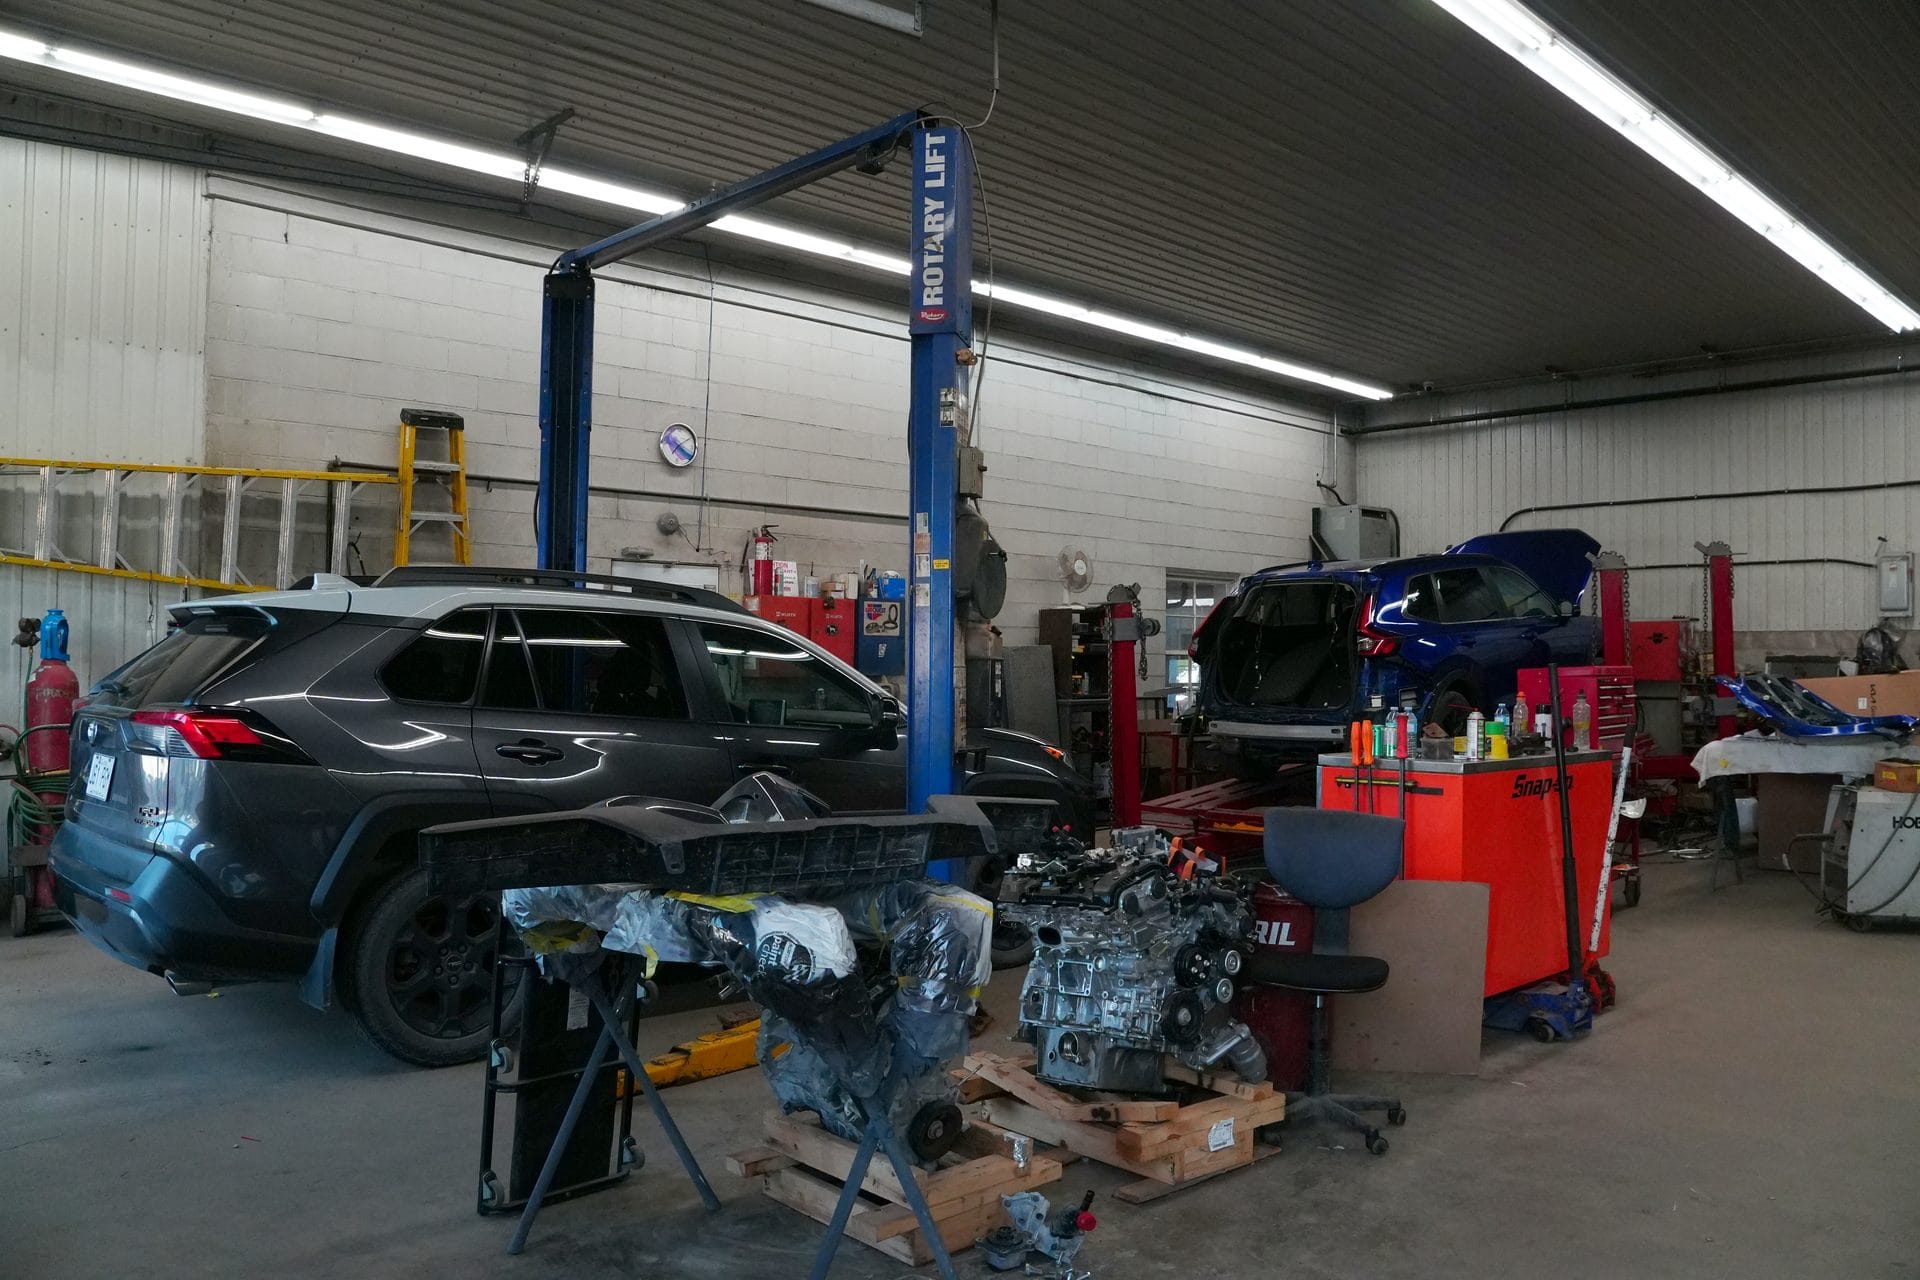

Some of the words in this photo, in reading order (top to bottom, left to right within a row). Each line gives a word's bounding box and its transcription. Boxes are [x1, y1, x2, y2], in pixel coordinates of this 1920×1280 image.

[924, 133, 946, 188] LIFT
[923, 197, 945, 306] ROTARY
[767, 934, 783, 967] paint
[1255, 920, 1296, 946] RIL
